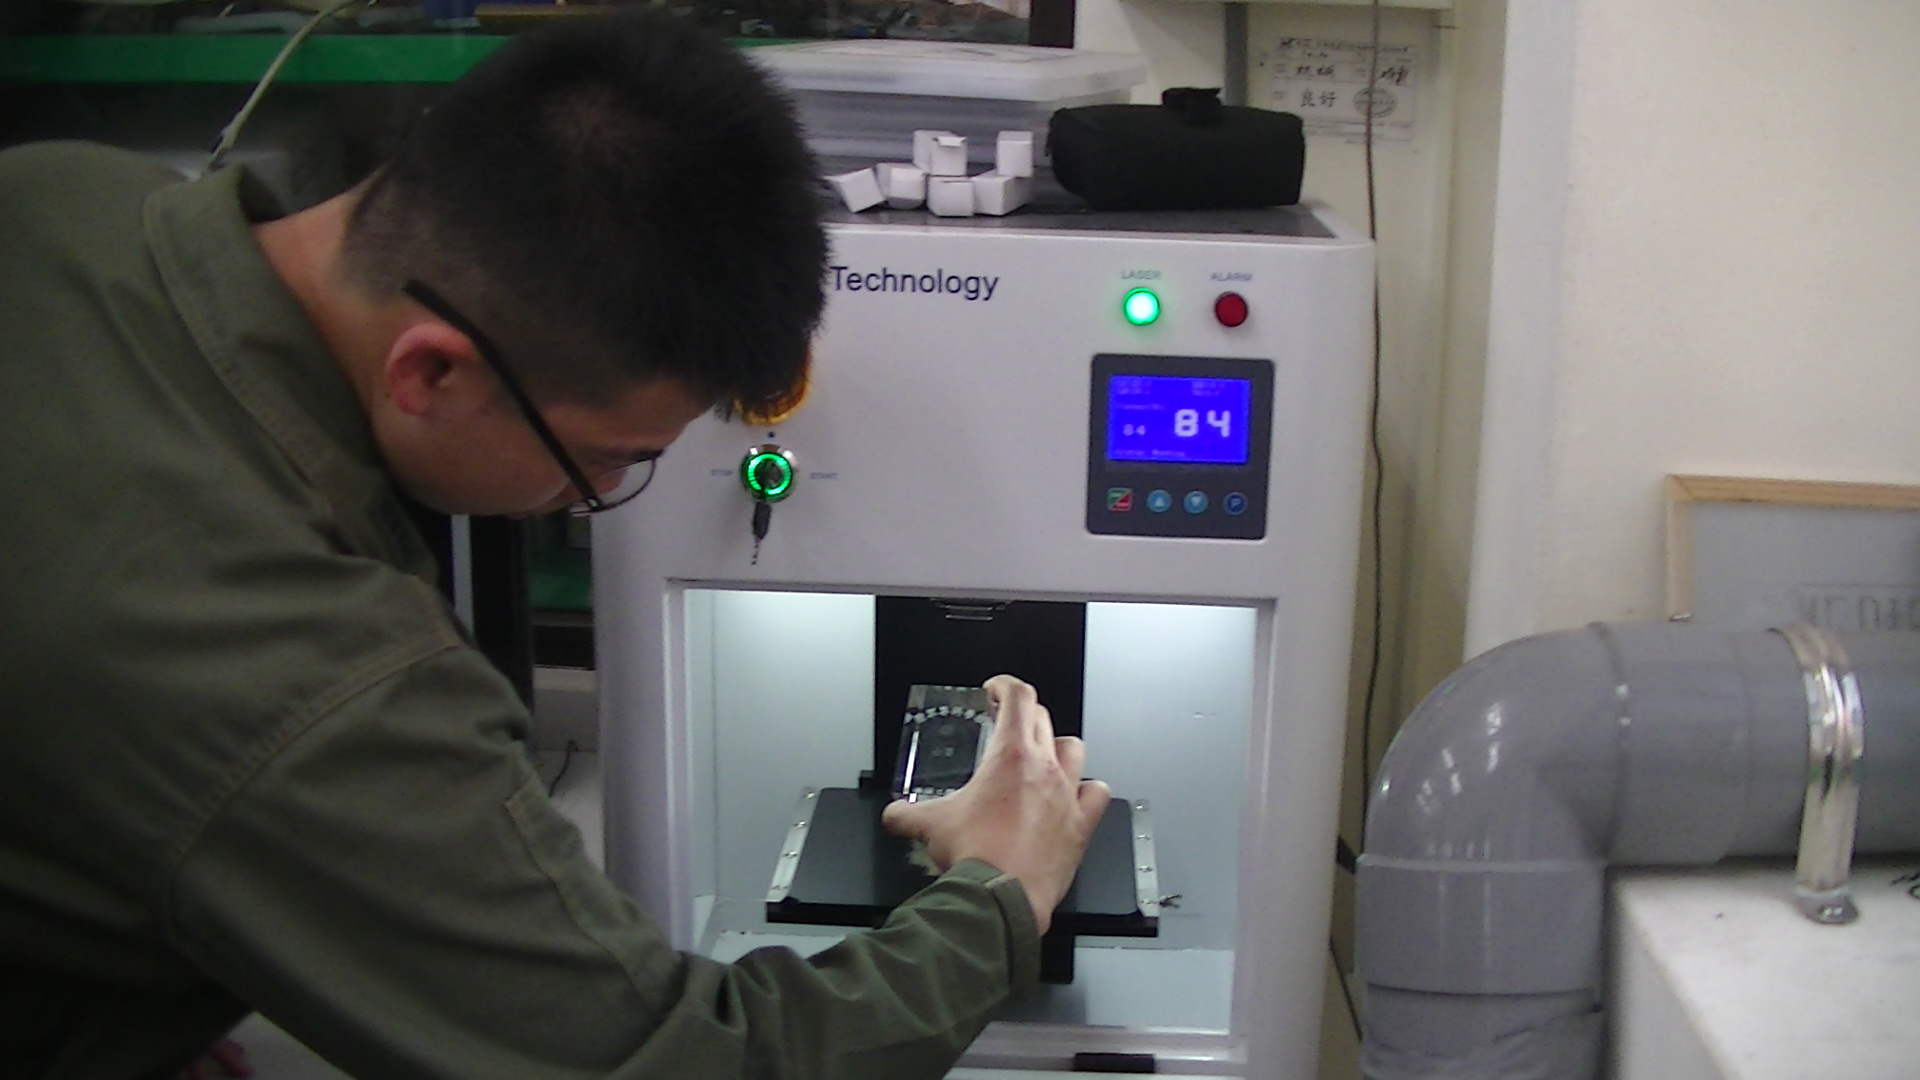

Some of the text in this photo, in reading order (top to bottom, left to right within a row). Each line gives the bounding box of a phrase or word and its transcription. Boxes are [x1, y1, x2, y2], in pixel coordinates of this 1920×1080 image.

[1121, 269, 1161, 280] LASER
[1210, 272, 1252, 282] ALARM
[830, 265, 1000, 301] Technology
[1122, 423, 1147, 437] 84
[1173, 408, 1232, 438] 84
